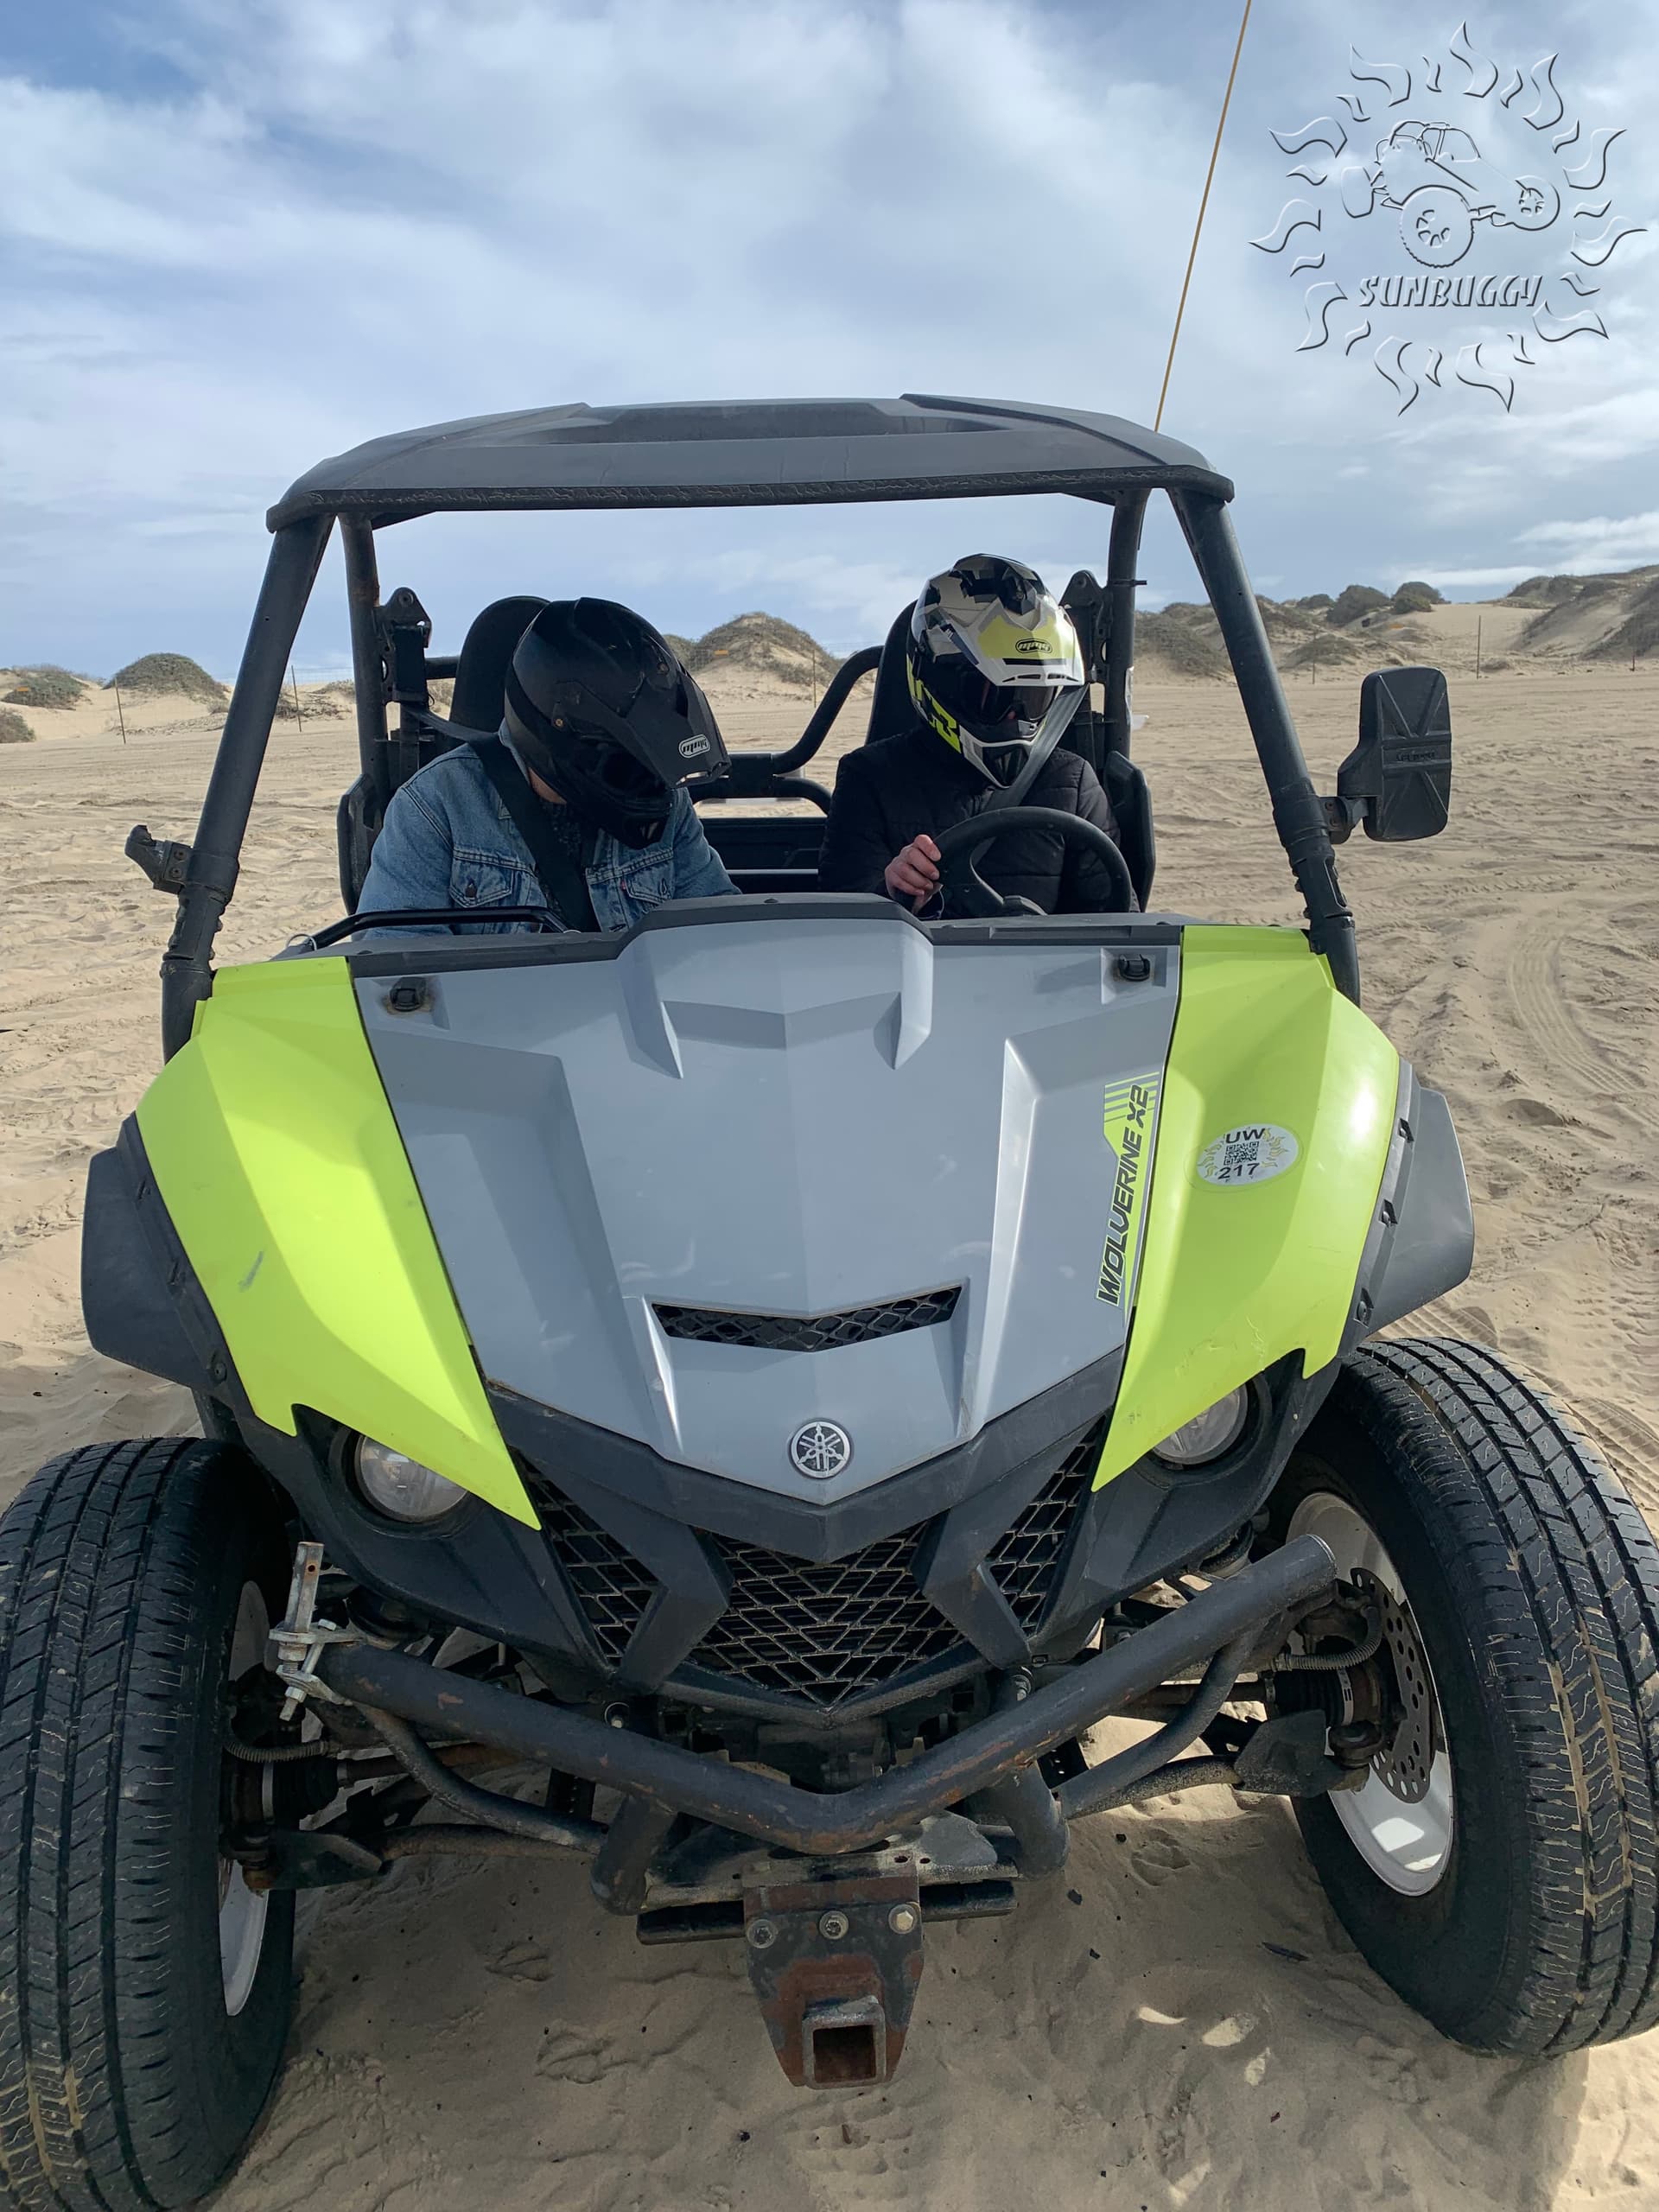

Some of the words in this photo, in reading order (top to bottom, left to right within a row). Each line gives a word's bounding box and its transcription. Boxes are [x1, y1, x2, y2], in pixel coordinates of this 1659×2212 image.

[1225, 1128, 1266, 1144] UW
[1217, 1162, 1260, 1179] 217
[1096, 1126, 1142, 1306] WOLVERINE
[1127, 1084, 1149, 1128] X2
